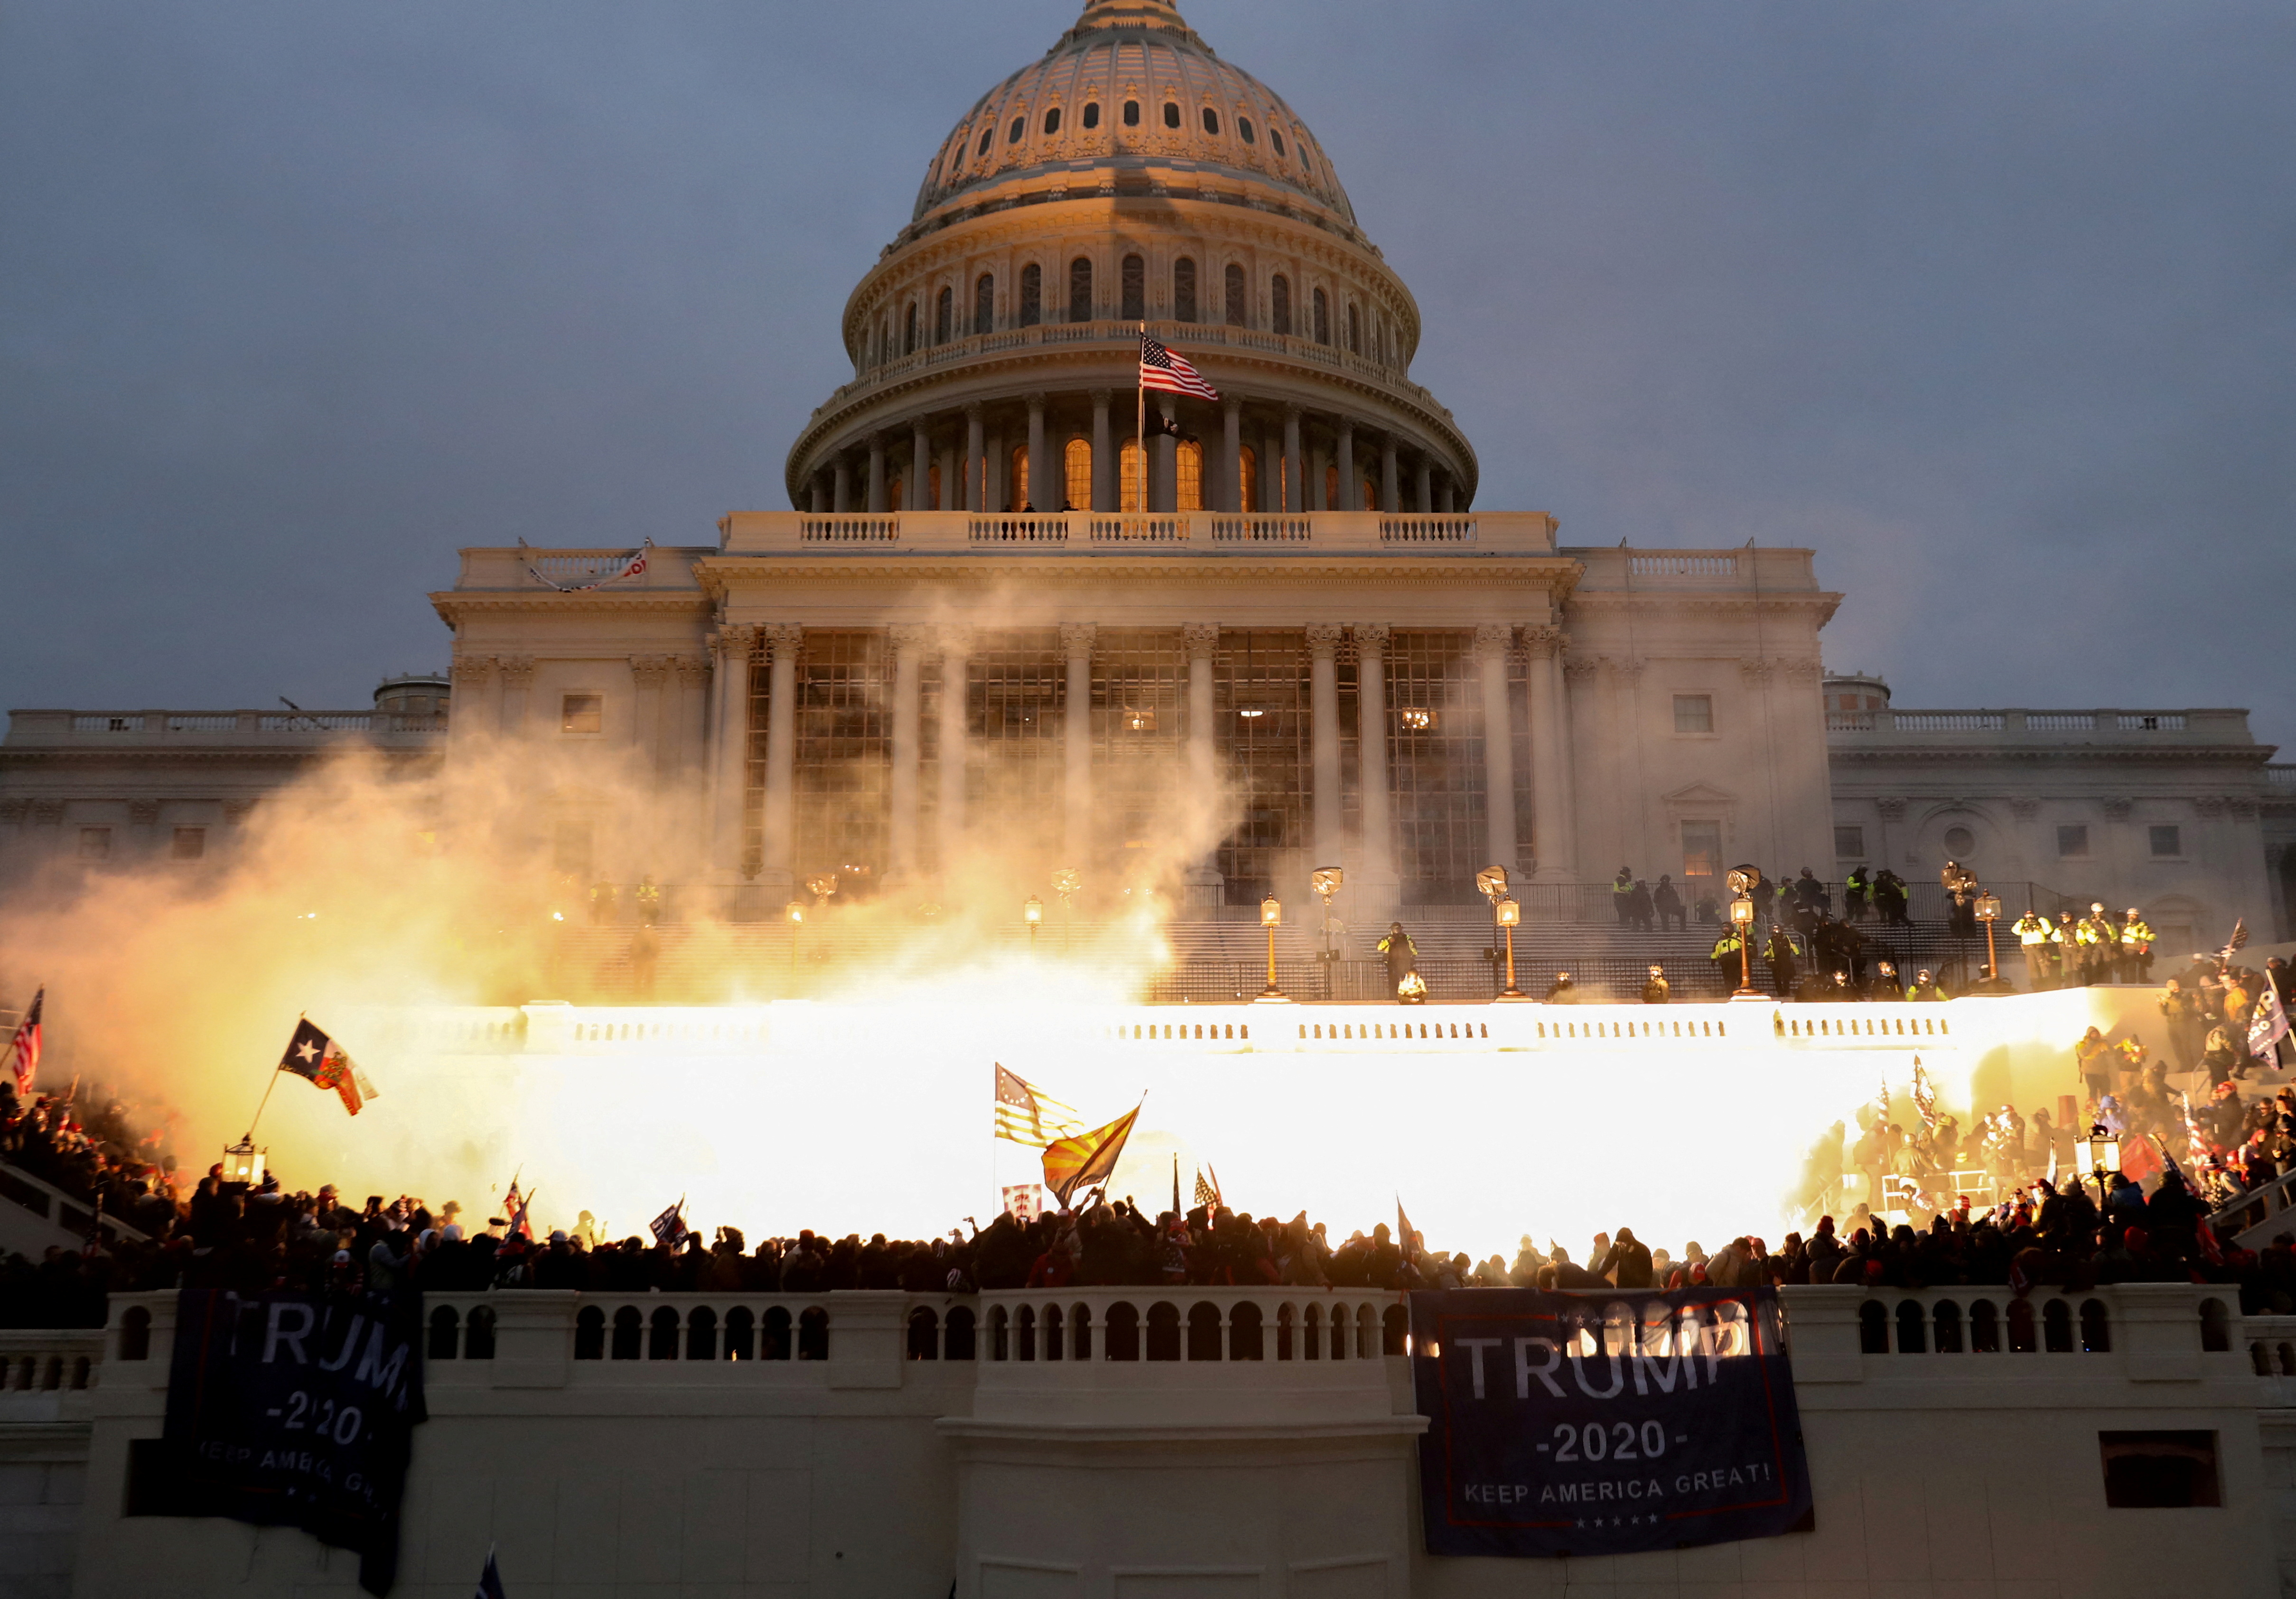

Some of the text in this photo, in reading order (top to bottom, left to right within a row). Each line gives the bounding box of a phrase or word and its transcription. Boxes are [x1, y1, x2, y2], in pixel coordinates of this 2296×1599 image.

[225, 1291, 409, 1413] TRUM
[1454, 1321, 1744, 1399] TRUMP
[1536, 1420, 1688, 1462] -2020-
[1465, 1463, 1771, 1504] KEEP AMERICA GREAT!
